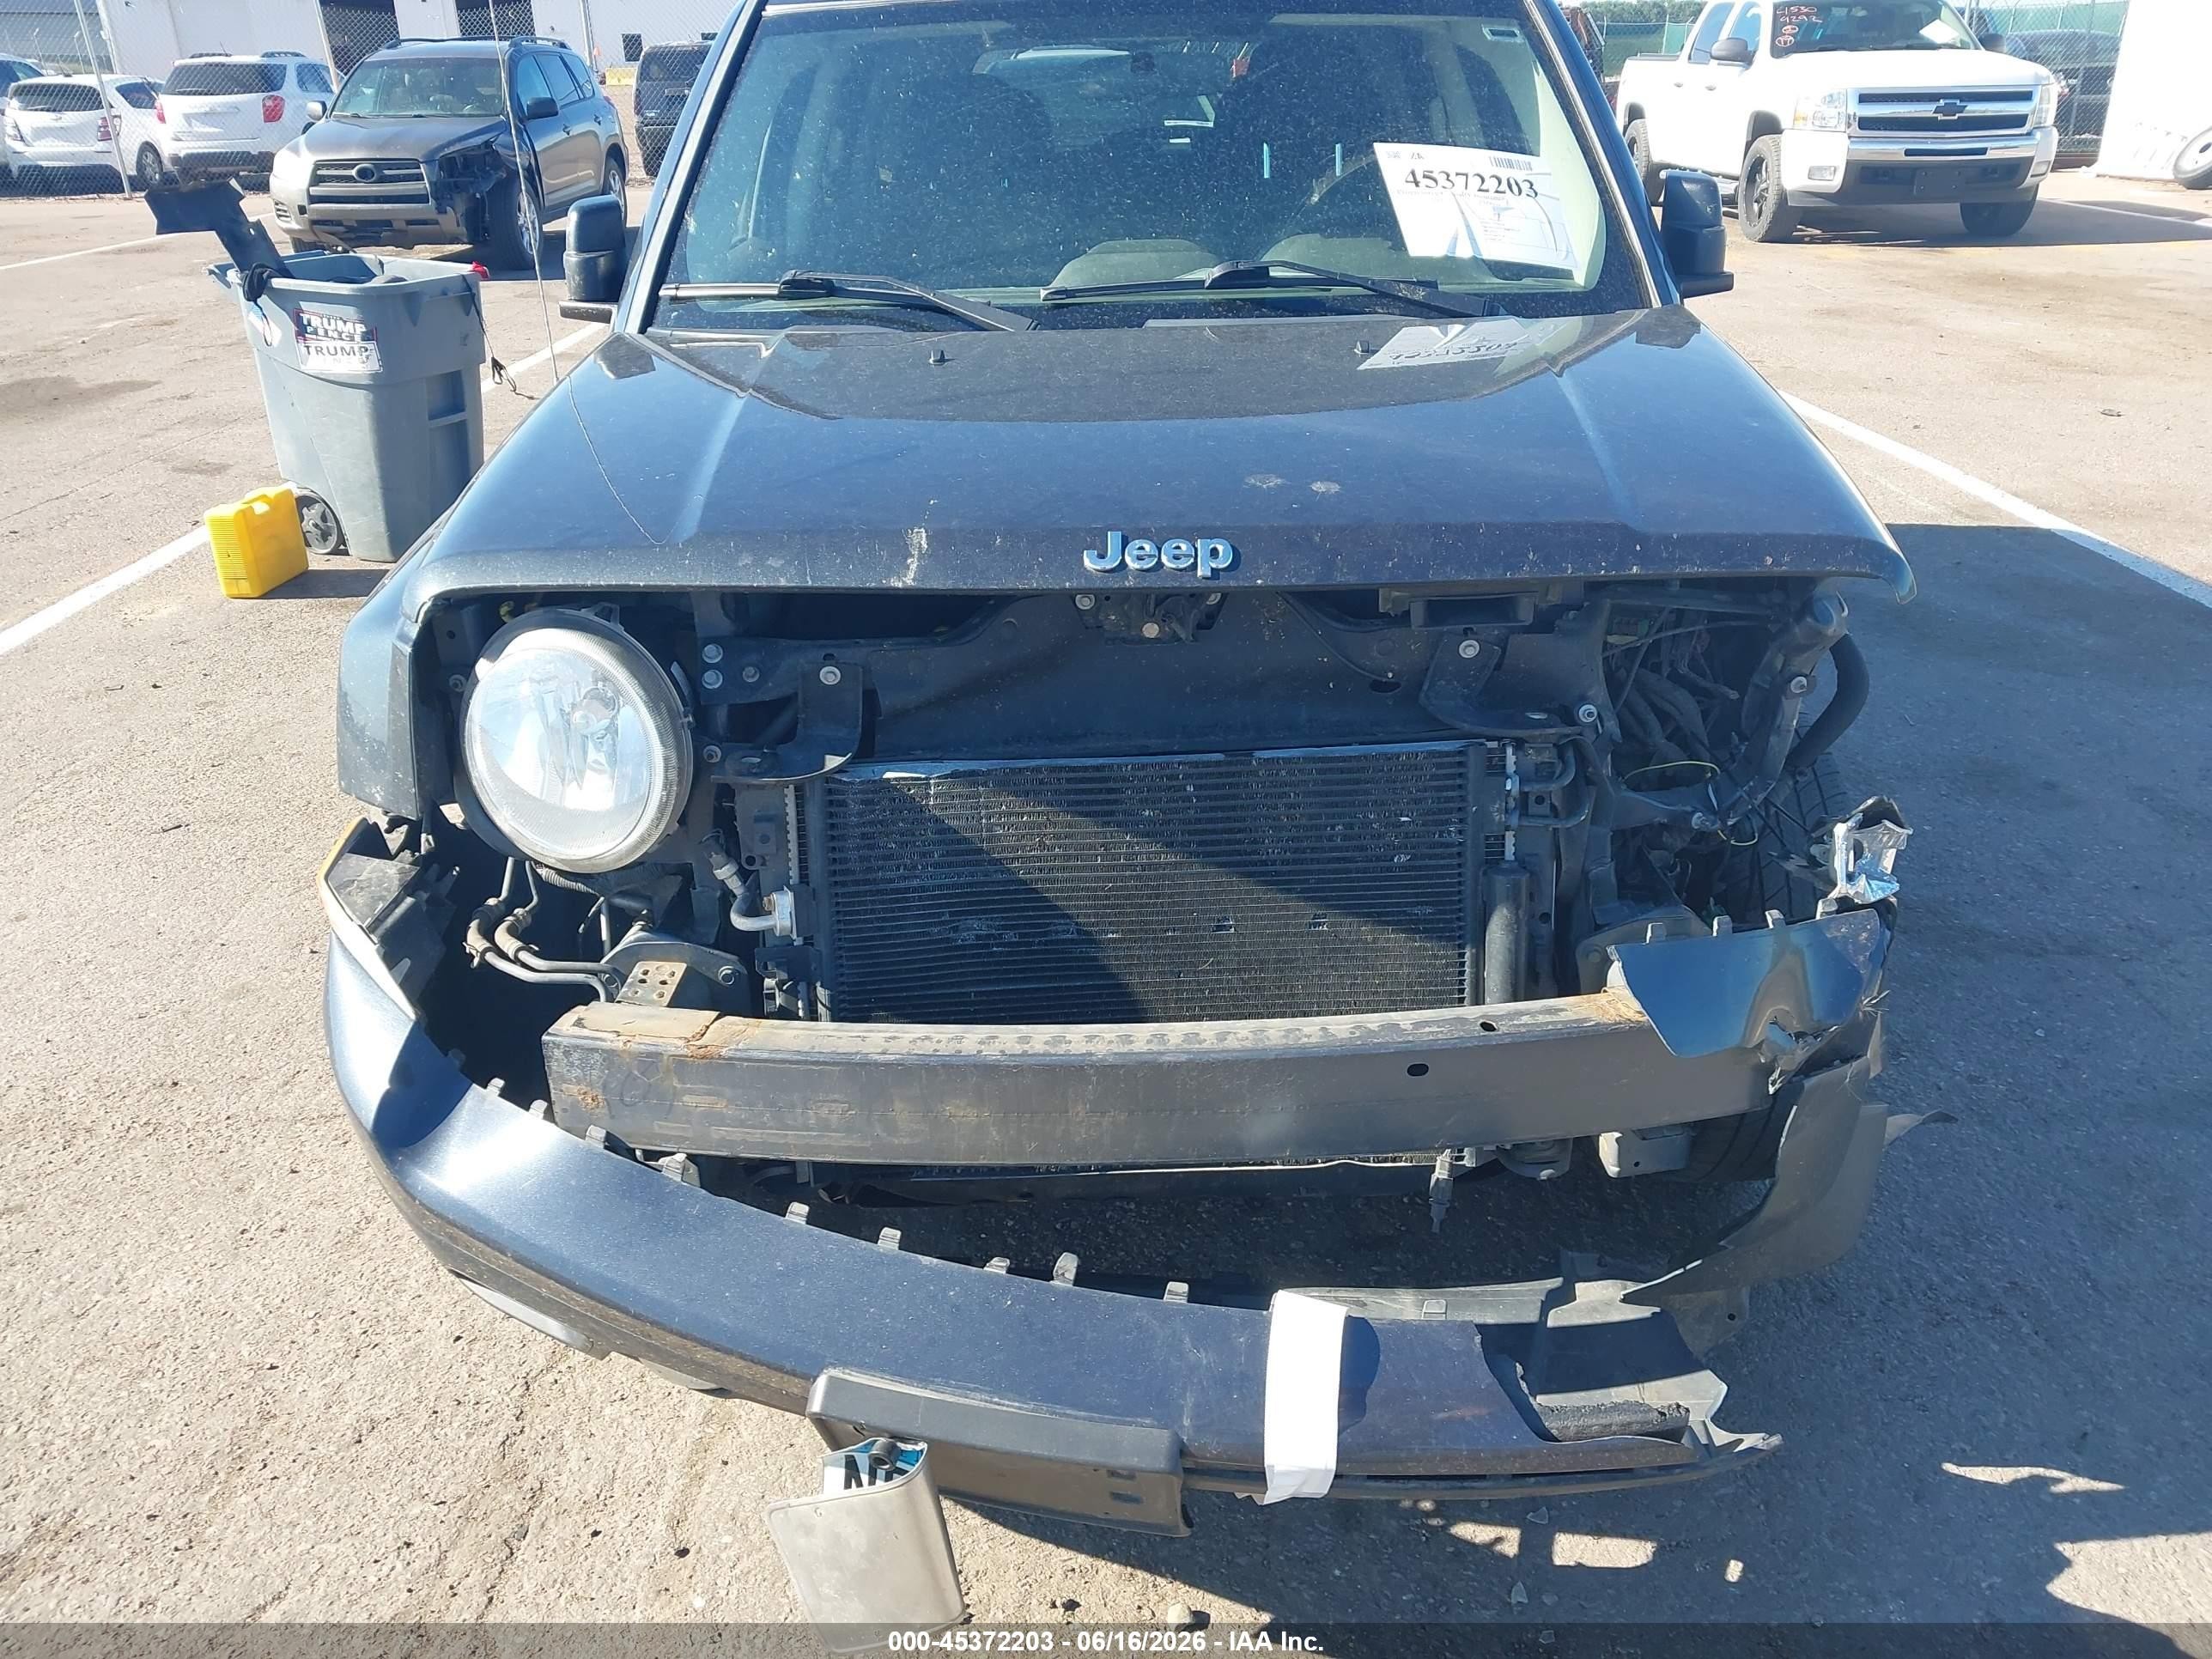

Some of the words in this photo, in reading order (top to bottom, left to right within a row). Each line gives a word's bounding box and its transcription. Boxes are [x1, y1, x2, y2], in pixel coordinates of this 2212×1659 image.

[1405, 168, 1539, 198] 45372203
[300, 313, 367, 334] TRUMP
[306, 325, 362, 343] PENCE
[303, 344, 369, 357] TRUMP
[1083, 531, 1233, 578] Jeep
